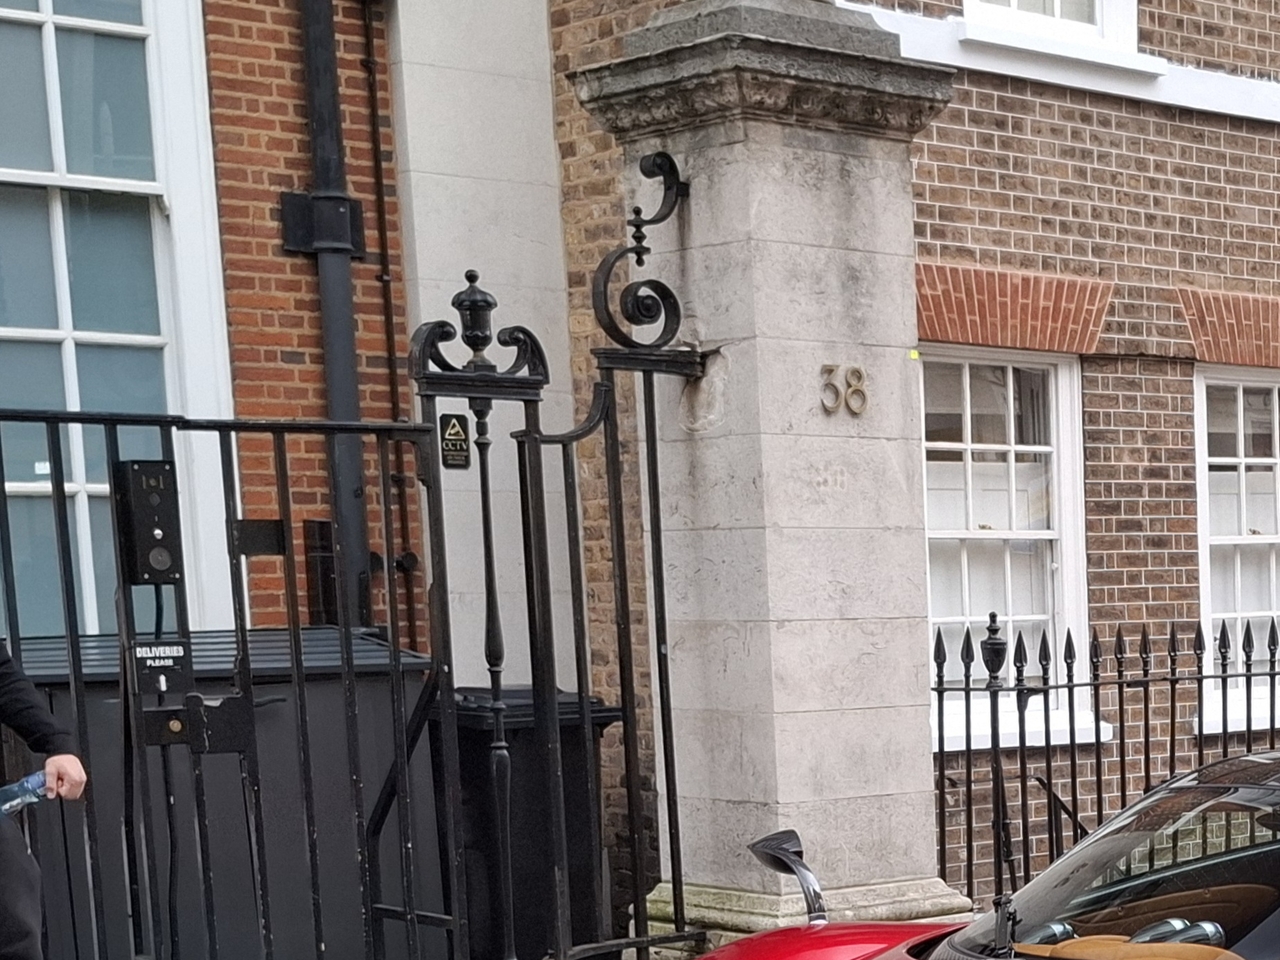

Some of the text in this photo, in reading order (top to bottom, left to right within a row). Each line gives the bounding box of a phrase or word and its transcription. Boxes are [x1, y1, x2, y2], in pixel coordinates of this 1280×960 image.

[820, 364, 868, 416] 38
[442, 440, 469, 450] CCTV
[136, 645, 184, 658] DELIVERIES
[146, 658, 174, 667] PLEASE
